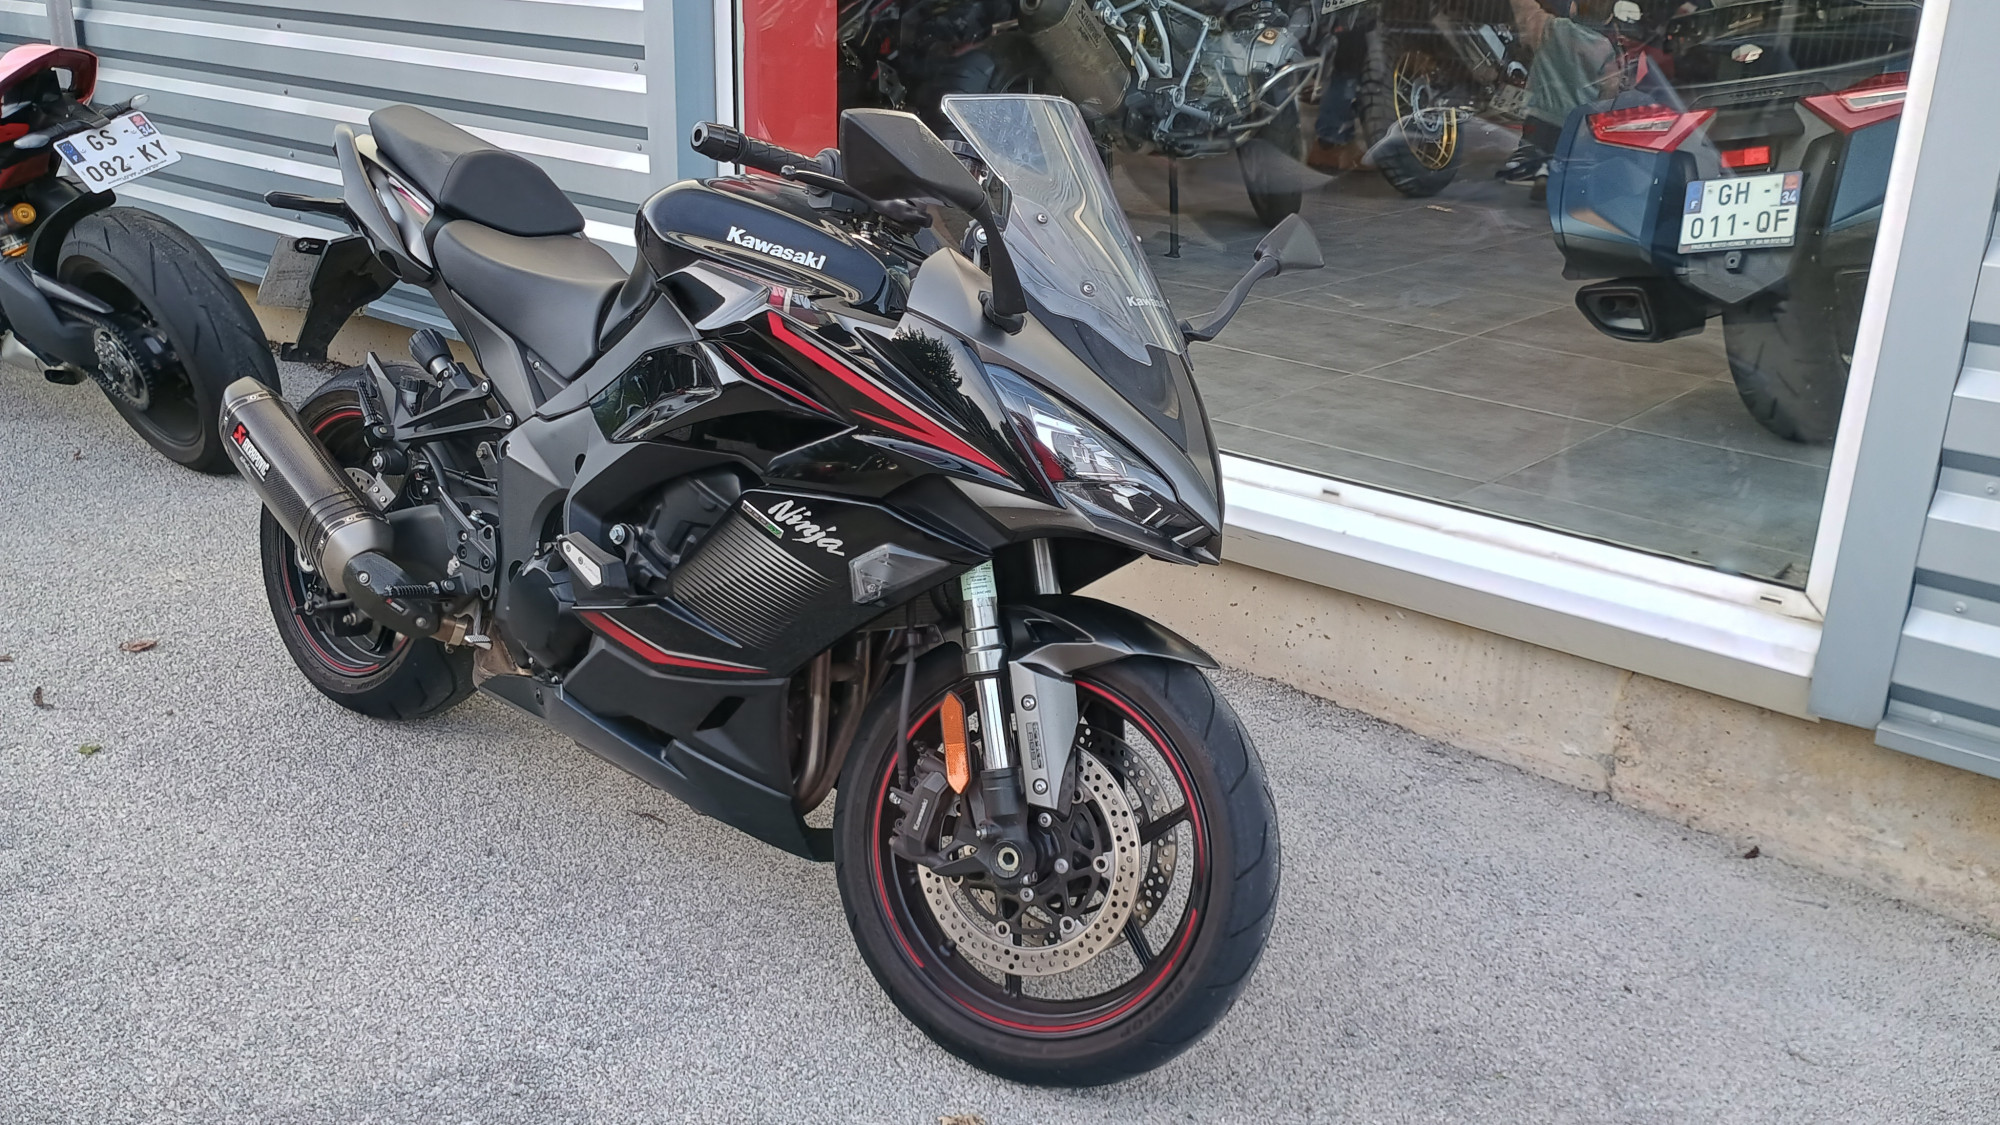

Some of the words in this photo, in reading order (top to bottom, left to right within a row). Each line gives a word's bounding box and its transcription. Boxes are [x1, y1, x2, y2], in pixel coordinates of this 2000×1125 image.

[86, 130, 117, 151] GS
[138, 124, 154, 137] 34
[86, 139, 168, 182] 082-KY
[1718, 182, 1750, 205] GH
[1781, 191, 1797, 203] 34
[726, 226, 827, 270] Kawasaki
[768, 500, 845, 557] Ninja
